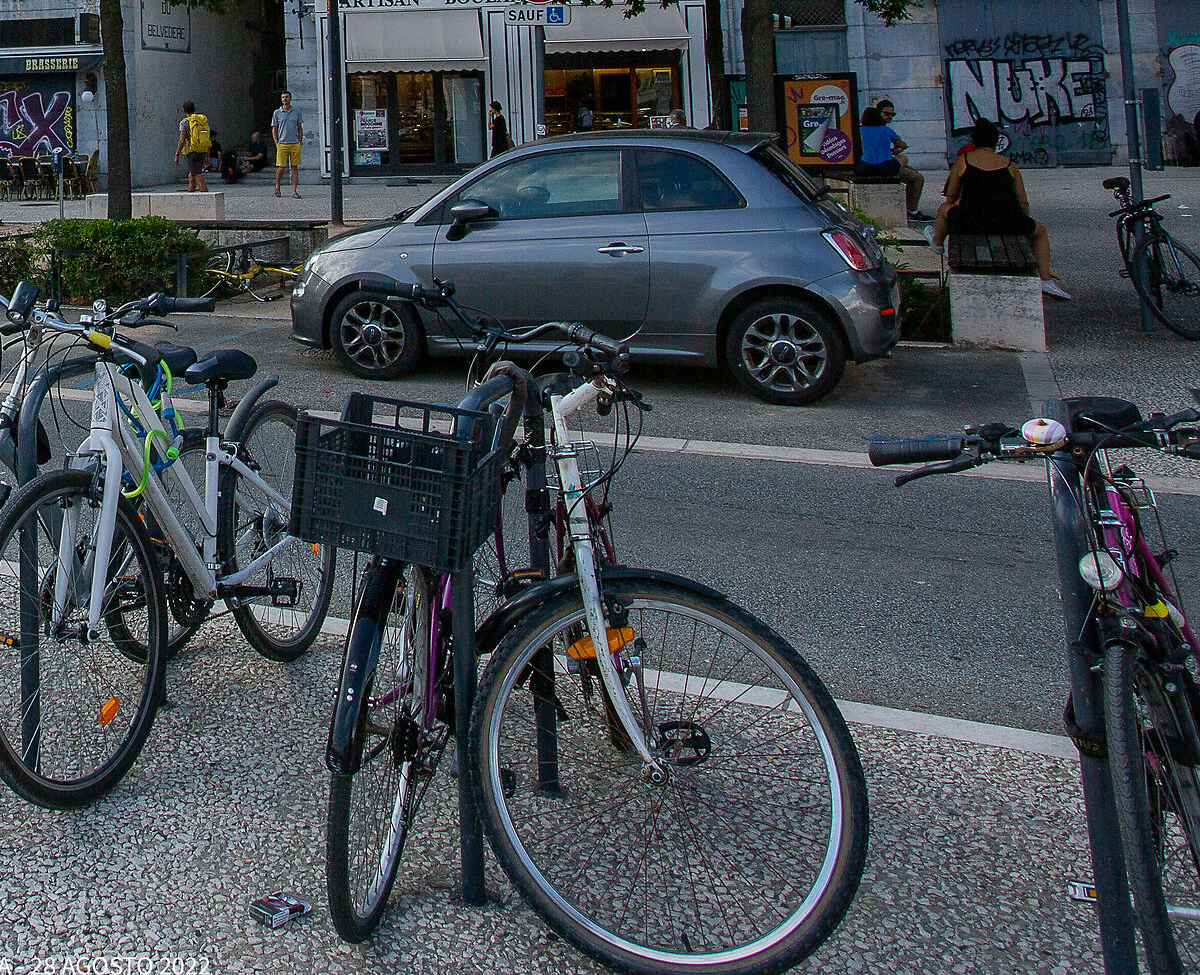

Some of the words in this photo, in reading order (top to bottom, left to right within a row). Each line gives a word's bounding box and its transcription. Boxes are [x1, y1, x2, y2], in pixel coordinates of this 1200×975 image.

[508, 9, 544, 21] SAUF
[147, 24, 185, 40] BELVEDERE
[25, 58, 78, 71] BRASSERIE
[945, 56, 1098, 137] NUKE
